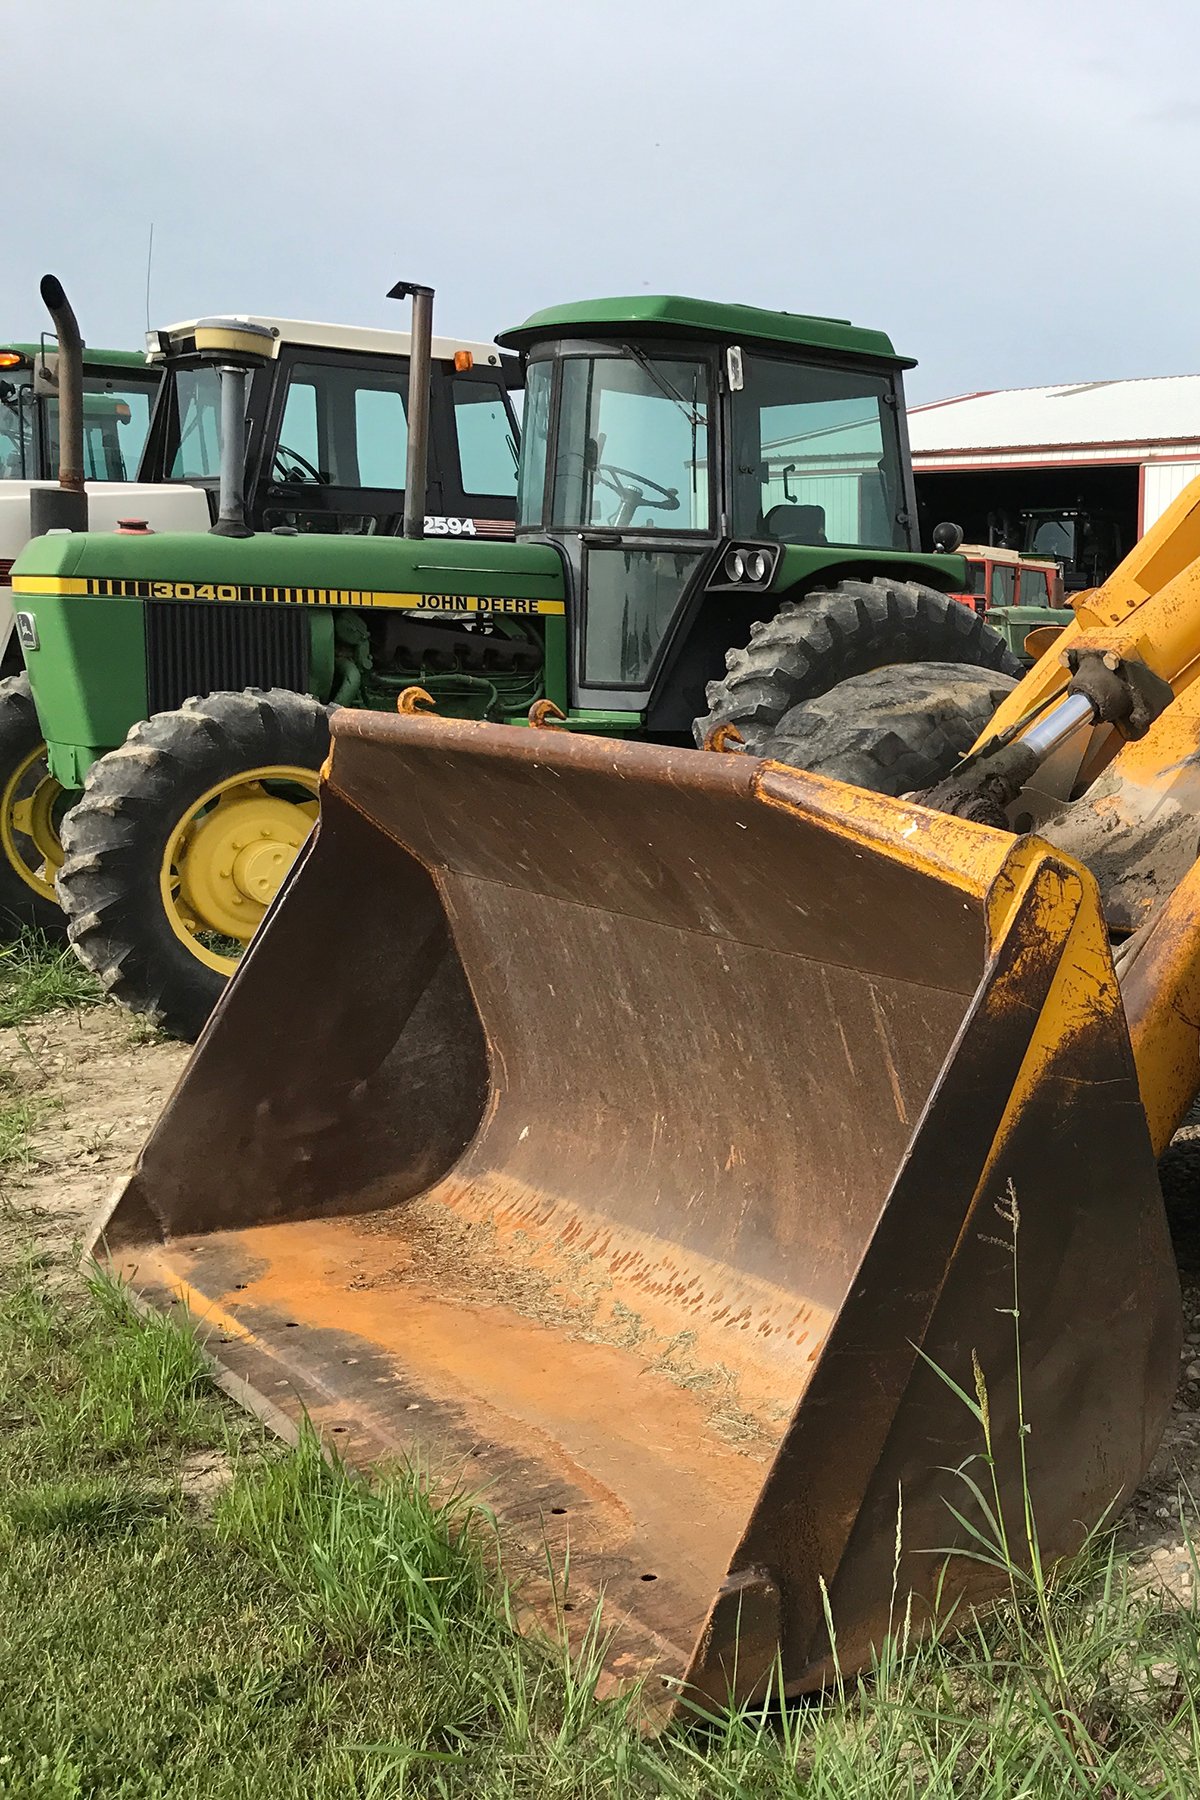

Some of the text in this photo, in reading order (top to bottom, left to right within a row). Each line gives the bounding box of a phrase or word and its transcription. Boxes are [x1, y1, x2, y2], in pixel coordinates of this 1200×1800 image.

[424, 516, 476, 535] 2594
[153, 582, 236, 601] 3040
[416, 595, 538, 613] JOHN DEERE
